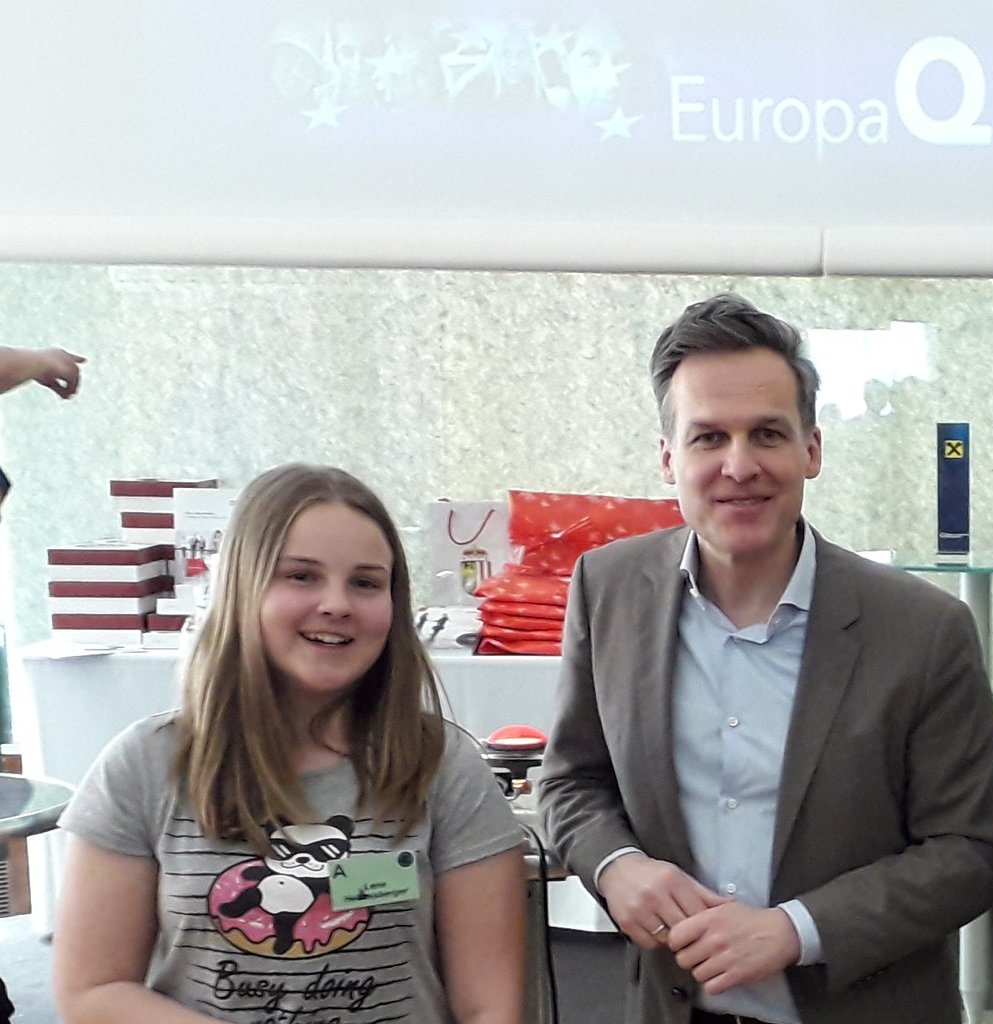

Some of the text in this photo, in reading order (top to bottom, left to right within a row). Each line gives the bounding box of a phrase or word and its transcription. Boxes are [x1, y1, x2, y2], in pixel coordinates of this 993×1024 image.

[332, 863, 347, 879] A
[215, 960, 374, 1013] Busy doing
